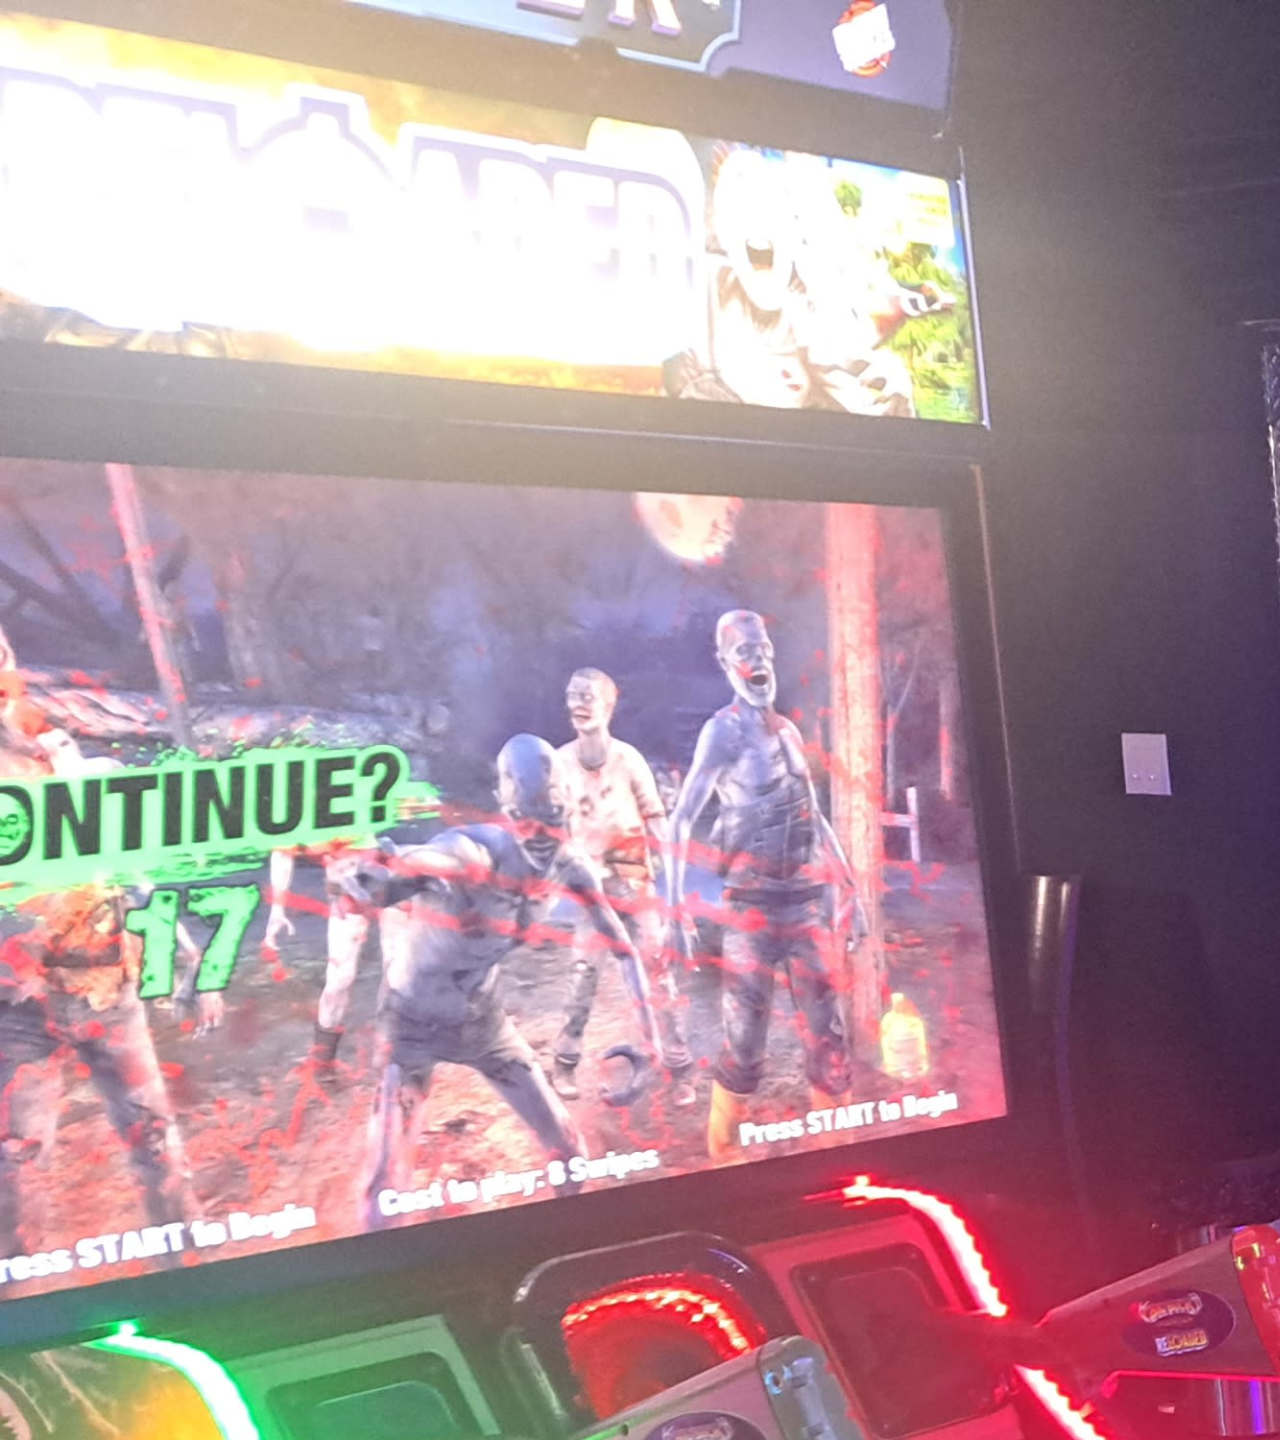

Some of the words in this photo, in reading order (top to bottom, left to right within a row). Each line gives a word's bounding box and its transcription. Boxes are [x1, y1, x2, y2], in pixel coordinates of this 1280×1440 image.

[125, 883, 260, 999] 17
[738, 1119, 806, 1147] Press
[805, 1102, 876, 1136] START
[877, 1099, 902, 1122] to
[901, 1090, 959, 1119] Begin
[377, 1181, 444, 1218] Cost
[446, 1179, 479, 1205] to
[478, 1169, 545, 1204] play:
[568, 1149, 661, 1184] Swipes
[75, 1221, 186, 1269] START
[189, 1217, 228, 1248] to
[228, 1201, 317, 1241] Begin
